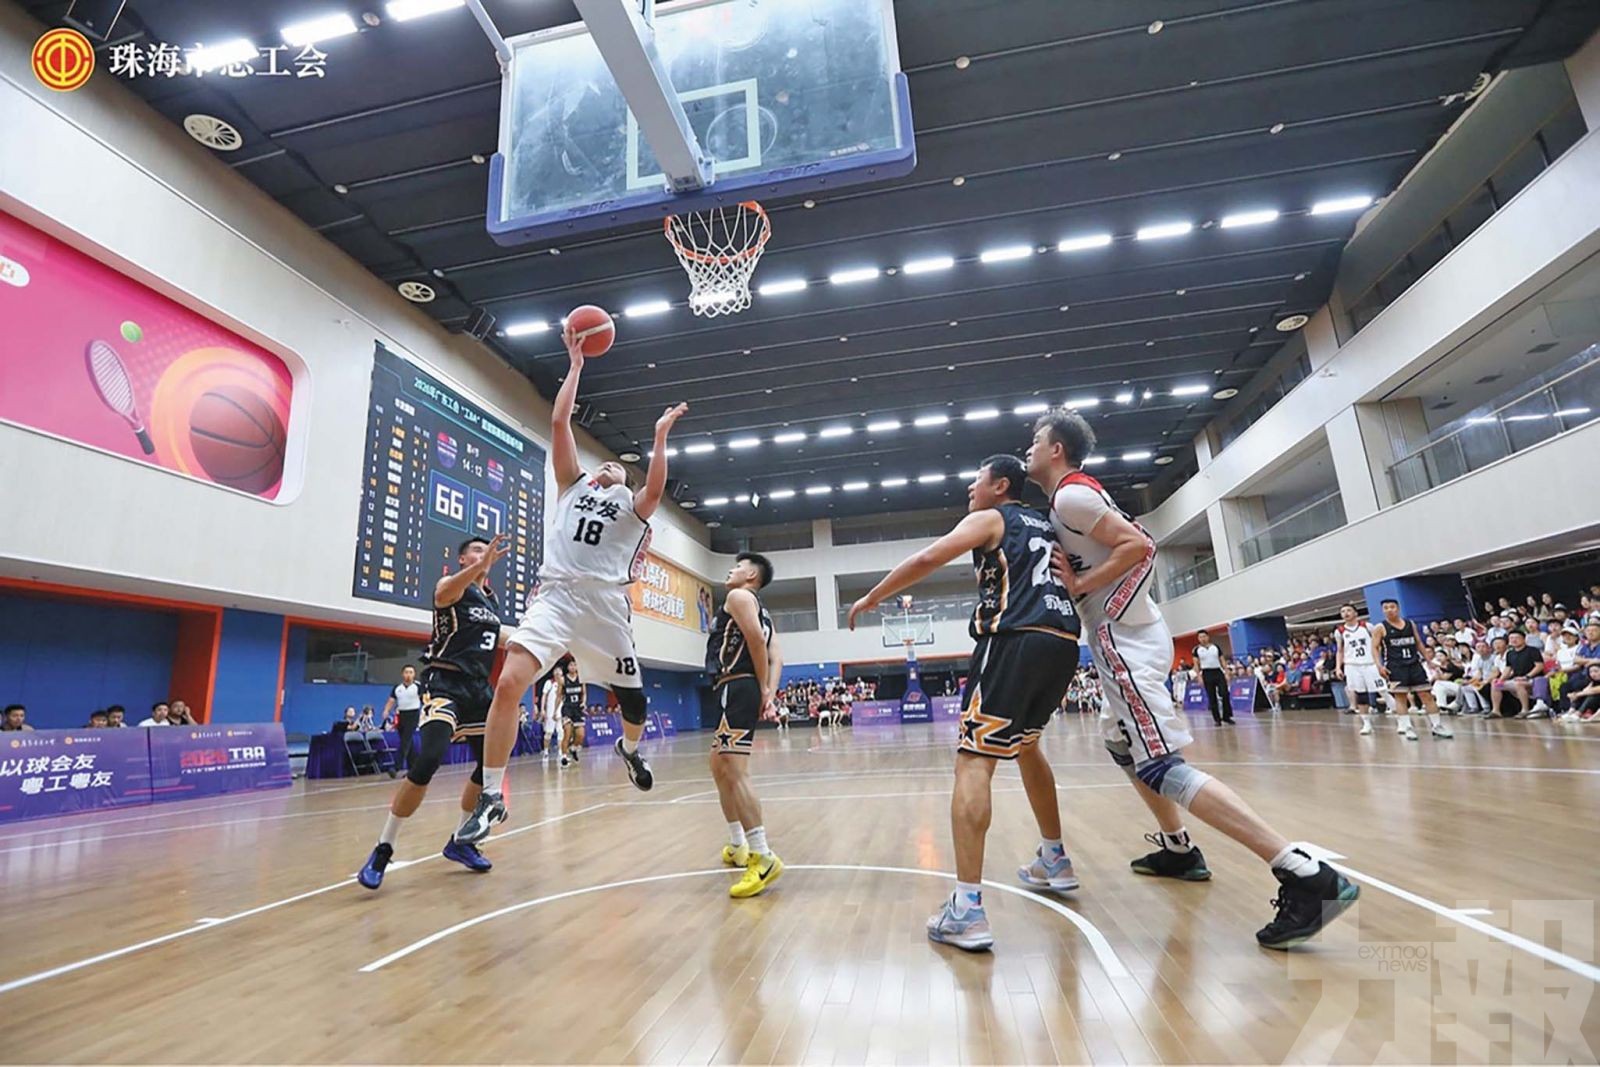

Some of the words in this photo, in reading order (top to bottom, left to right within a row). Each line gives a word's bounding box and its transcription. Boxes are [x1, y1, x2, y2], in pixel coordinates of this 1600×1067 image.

[435, 483, 464, 521] 66
[574, 494, 621, 521] 华发
[476, 501, 501, 535] 57
[573, 517, 604, 546] 18
[480, 631, 496, 650] 3
[615, 657, 636, 676] 18
[1375, 679, 1384, 688] 10
[0, 753, 96, 776] 以球会友
[228, 746, 265, 760] TBA
[20, 771, 114, 795] 粤工粤友
